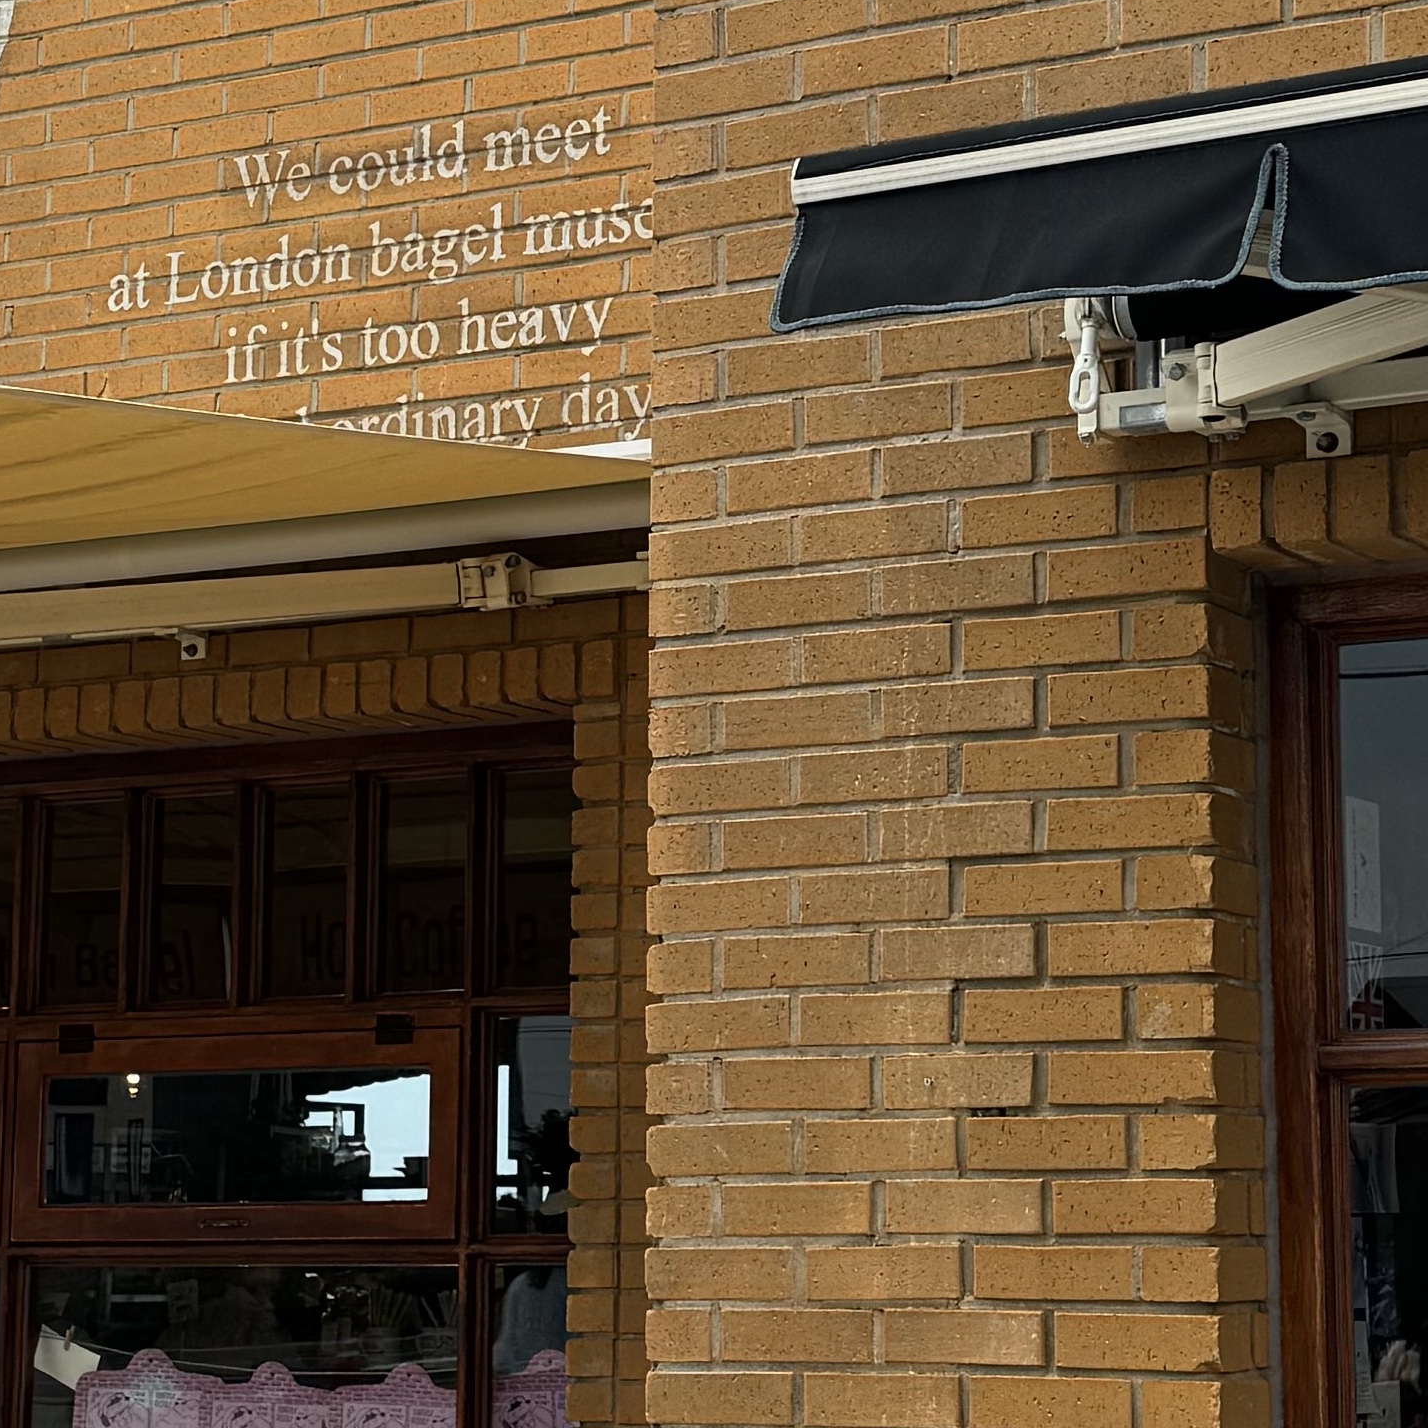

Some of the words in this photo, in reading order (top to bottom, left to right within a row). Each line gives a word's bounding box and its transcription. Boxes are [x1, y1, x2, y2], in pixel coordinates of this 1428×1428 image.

[233, 149, 312, 208] We
[328, 119, 468, 195] could
[483, 105, 613, 172] meet
[107, 261, 151, 313] at
[163, 234, 353, 306] London
[369, 202, 507, 284] bagel
[223, 324, 268, 384] if
[277, 318, 343, 377] it's
[361, 316, 441, 368] too
[456, 297, 615, 357] heavy
